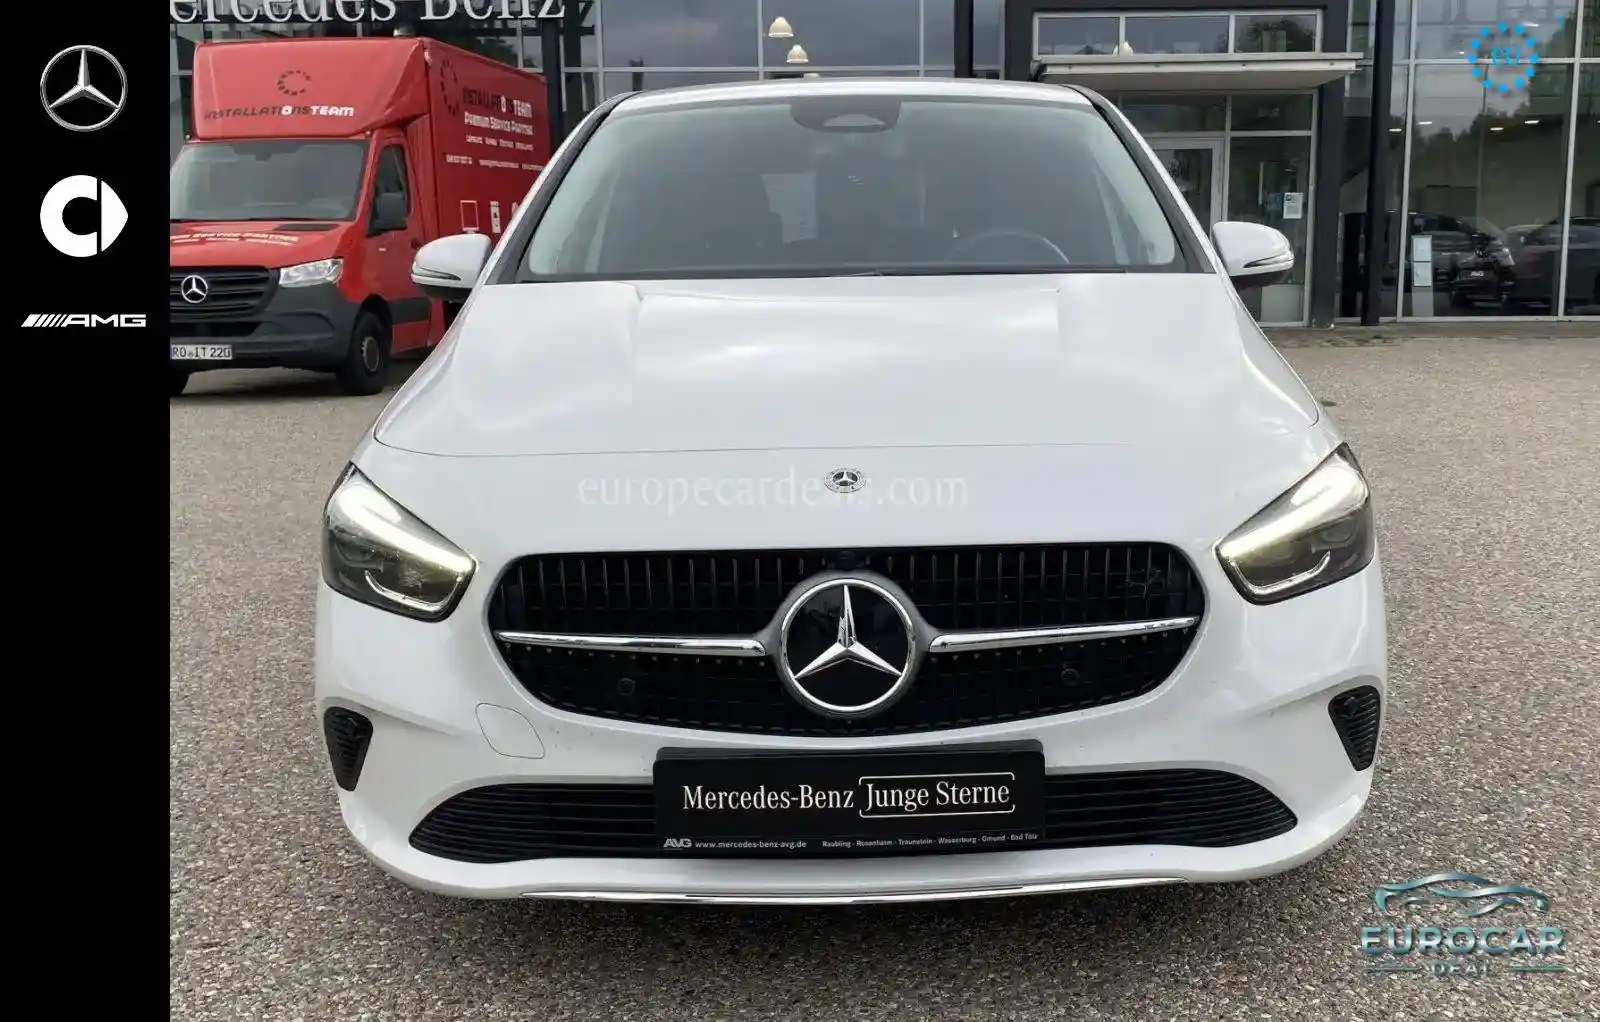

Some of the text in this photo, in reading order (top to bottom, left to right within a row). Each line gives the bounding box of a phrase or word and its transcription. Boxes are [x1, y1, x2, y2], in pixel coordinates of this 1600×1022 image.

[682, 780, 1010, 812] Mercedes-Benz Junge Sterne
[663, 838, 808, 850] AVG www.mercedes-benz-avg.de
